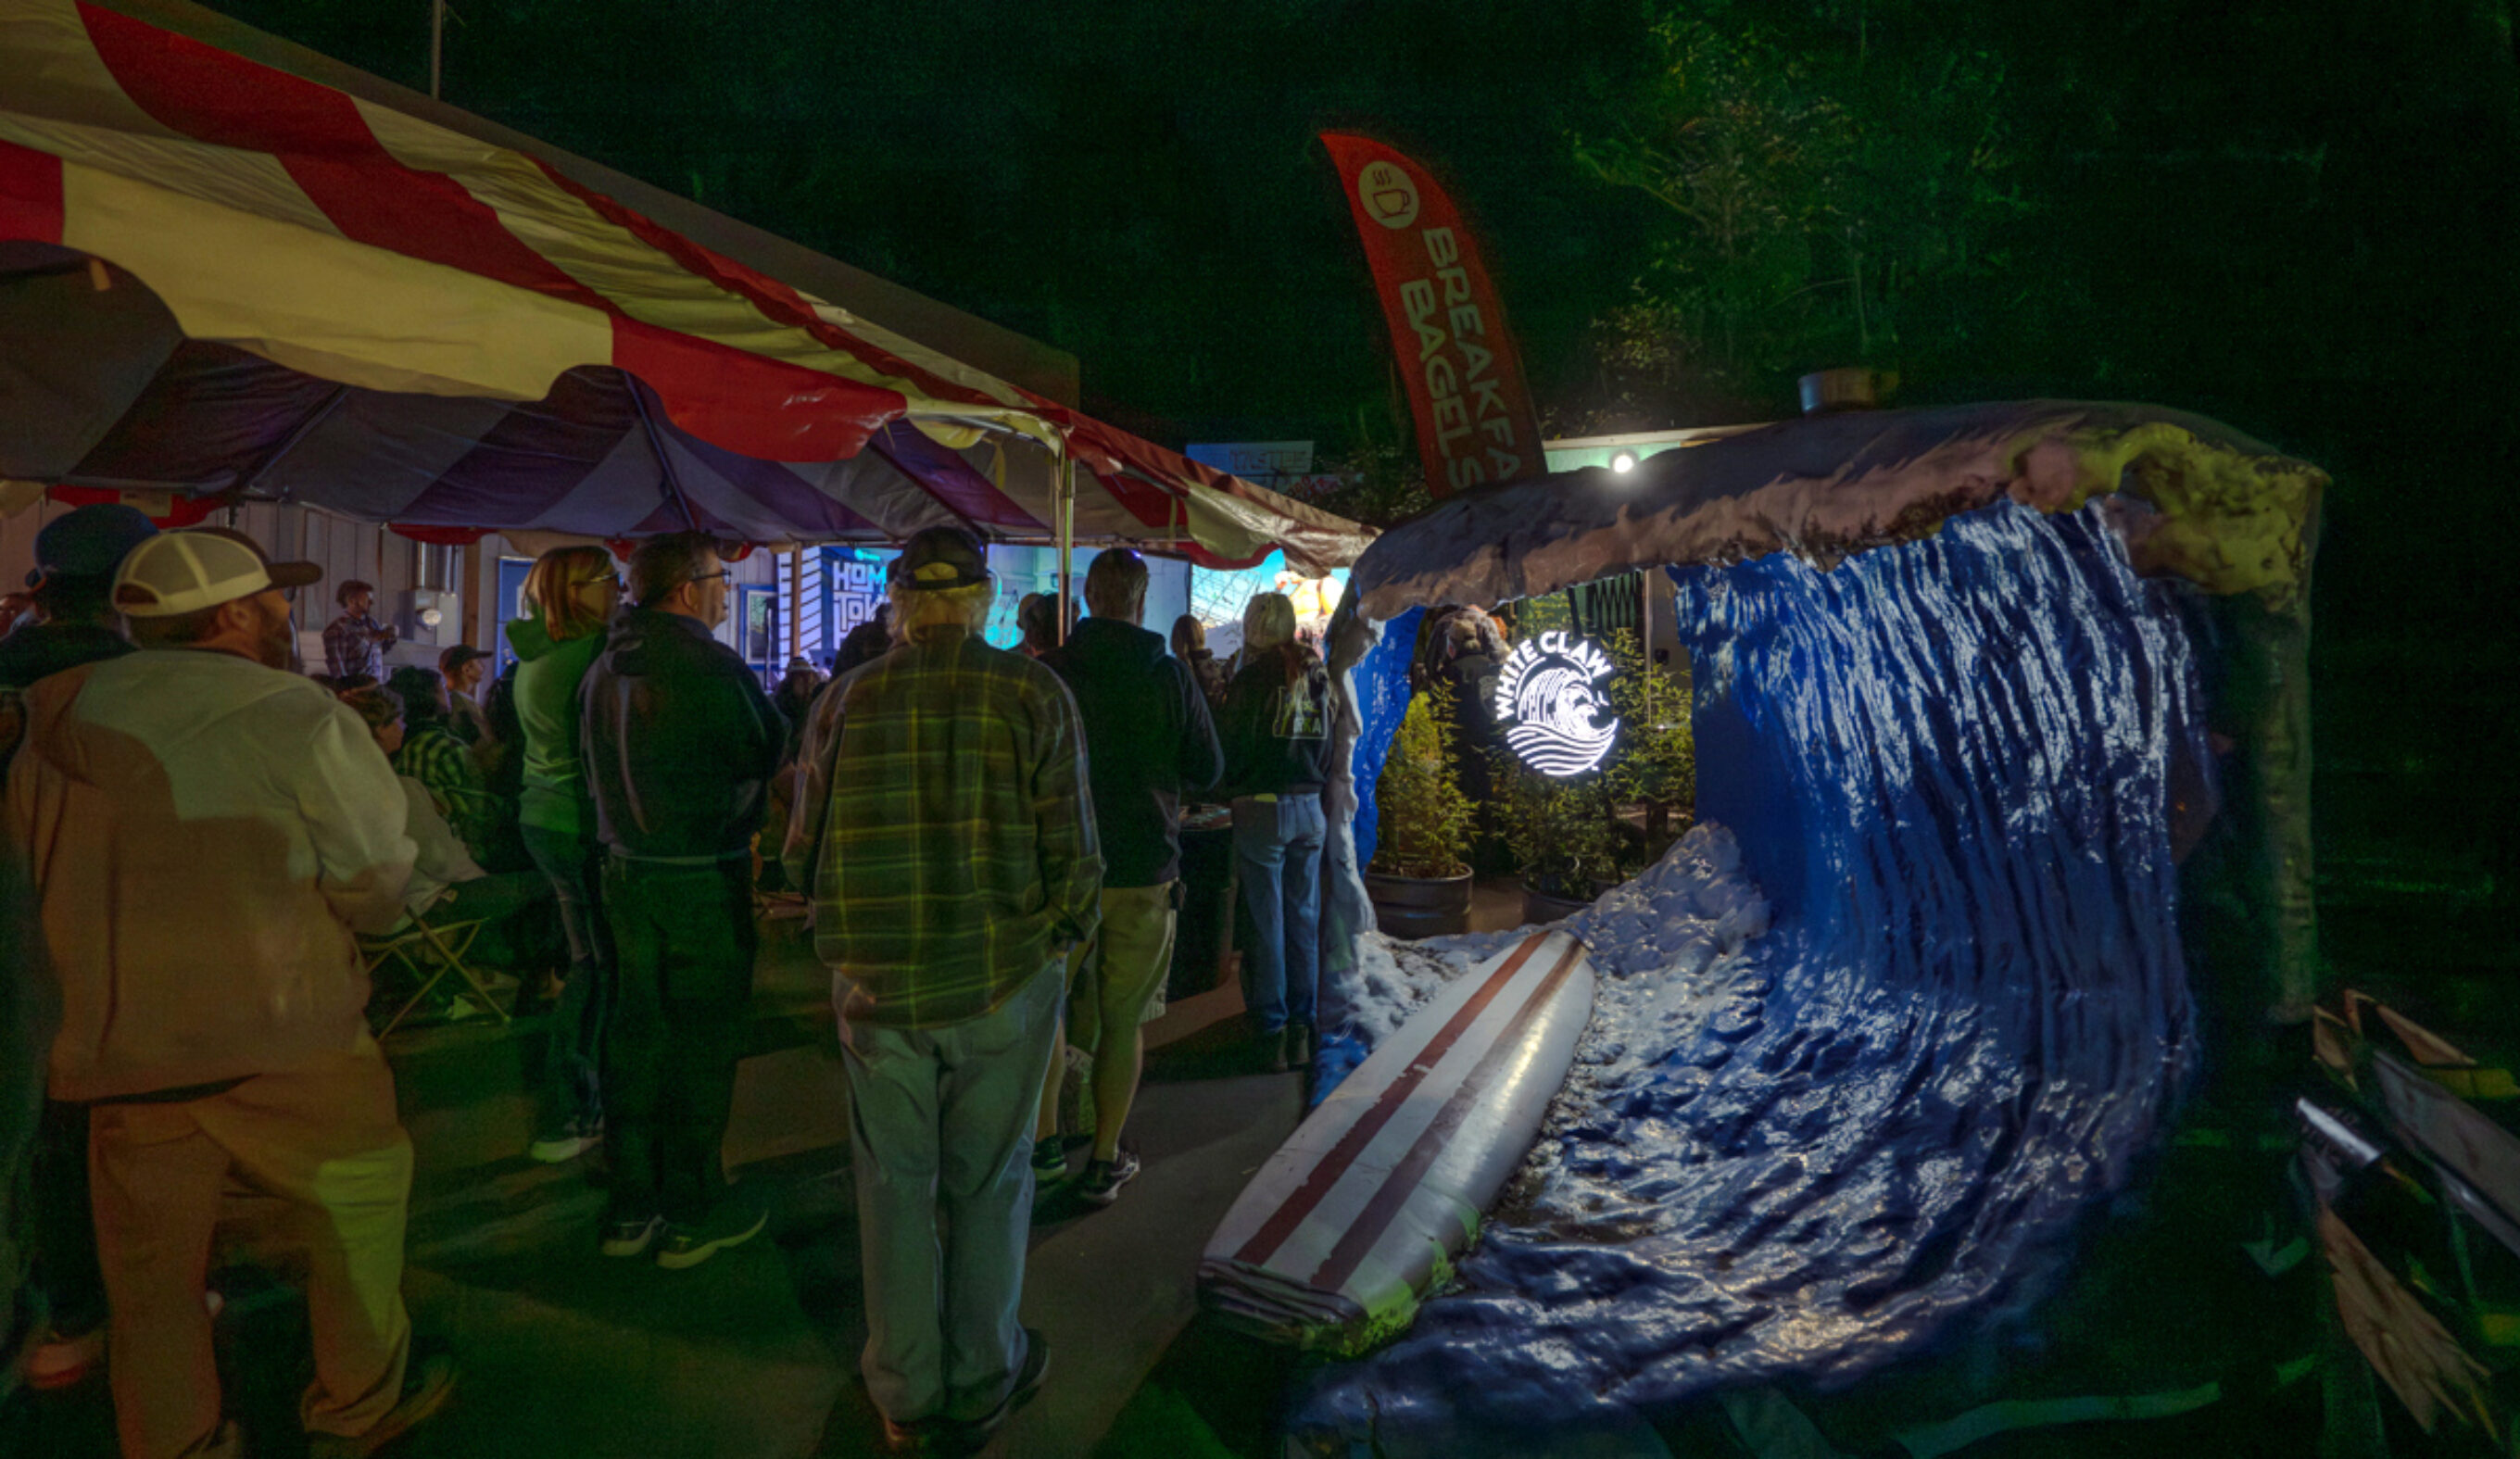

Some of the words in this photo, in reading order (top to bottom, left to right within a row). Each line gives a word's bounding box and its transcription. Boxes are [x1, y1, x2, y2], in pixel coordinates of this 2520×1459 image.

[1400, 279, 1482, 491] BAGELS
[1421, 226, 1522, 482] BREAKFA
[1494, 638, 1539, 721] WHITE
[1539, 630, 1613, 678] CLAW
